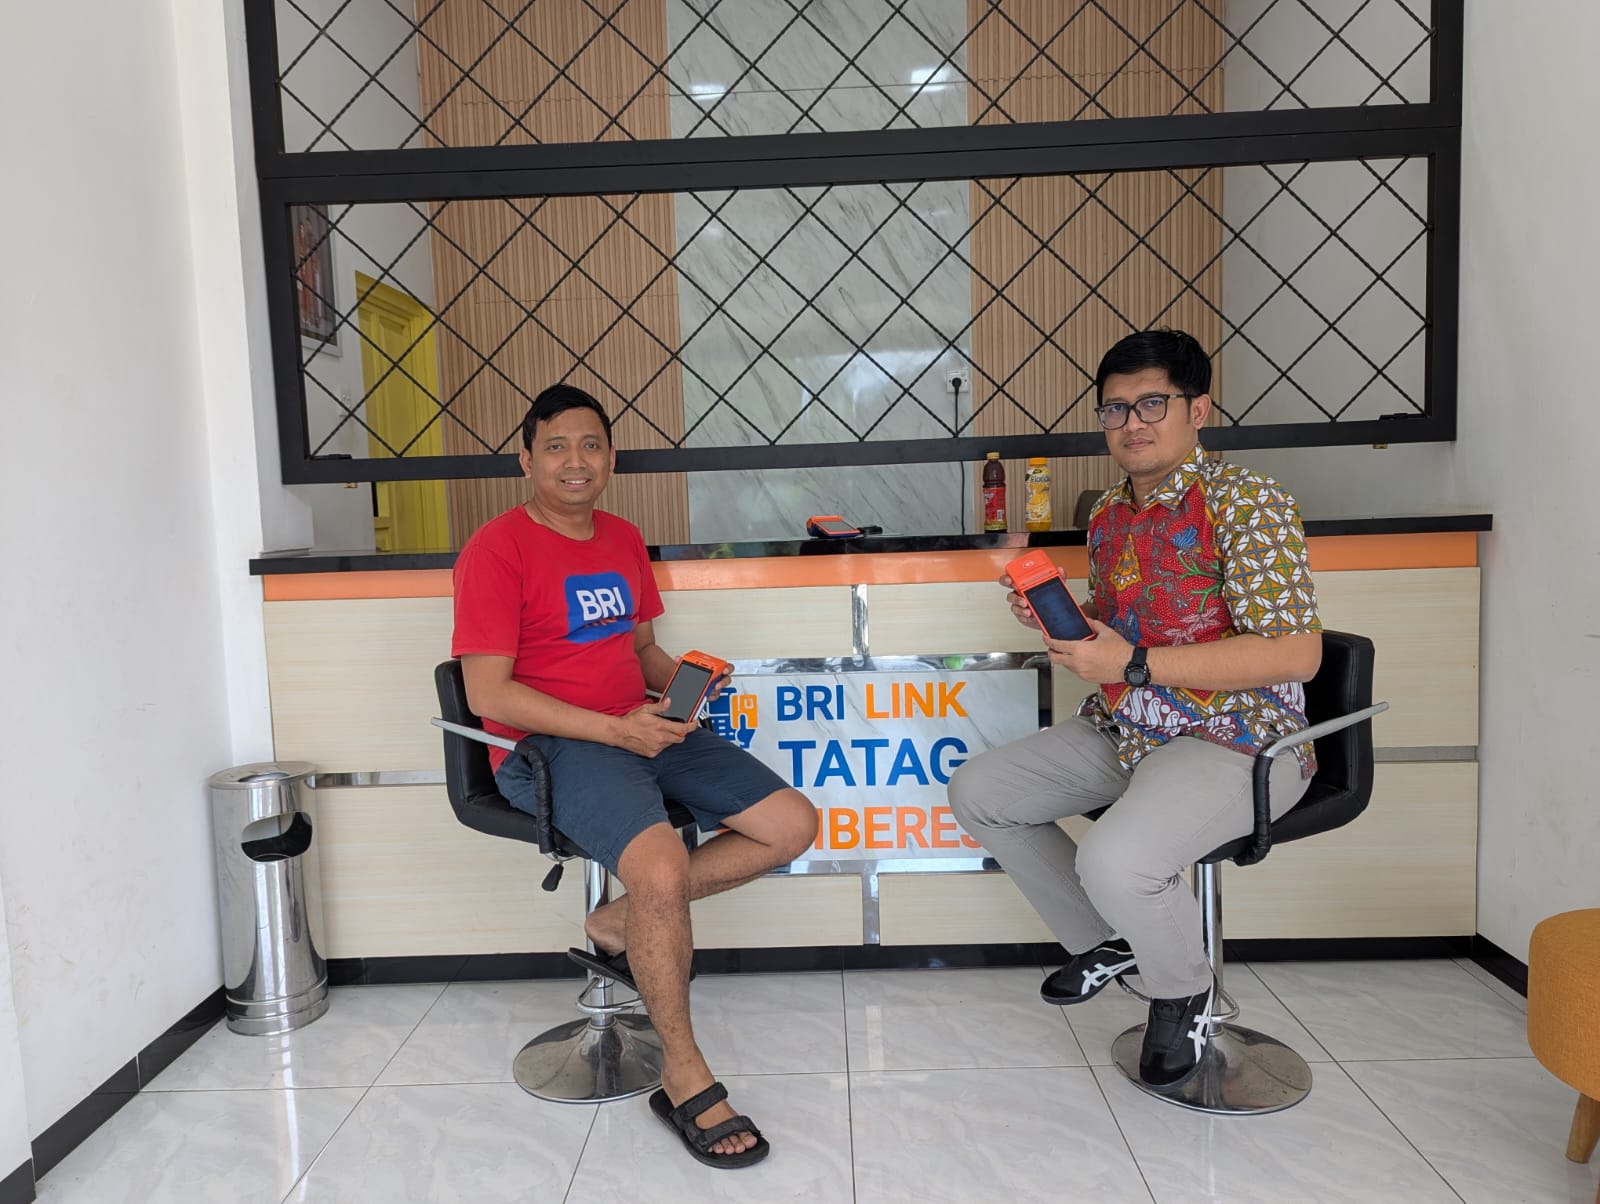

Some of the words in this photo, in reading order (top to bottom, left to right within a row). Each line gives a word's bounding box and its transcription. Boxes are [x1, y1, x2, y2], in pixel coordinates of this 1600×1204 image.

[575, 586, 626, 621] BRI
[776, 684, 845, 722] BRI
[865, 681, 968, 719] LINK
[778, 737, 969, 788] TATAG
